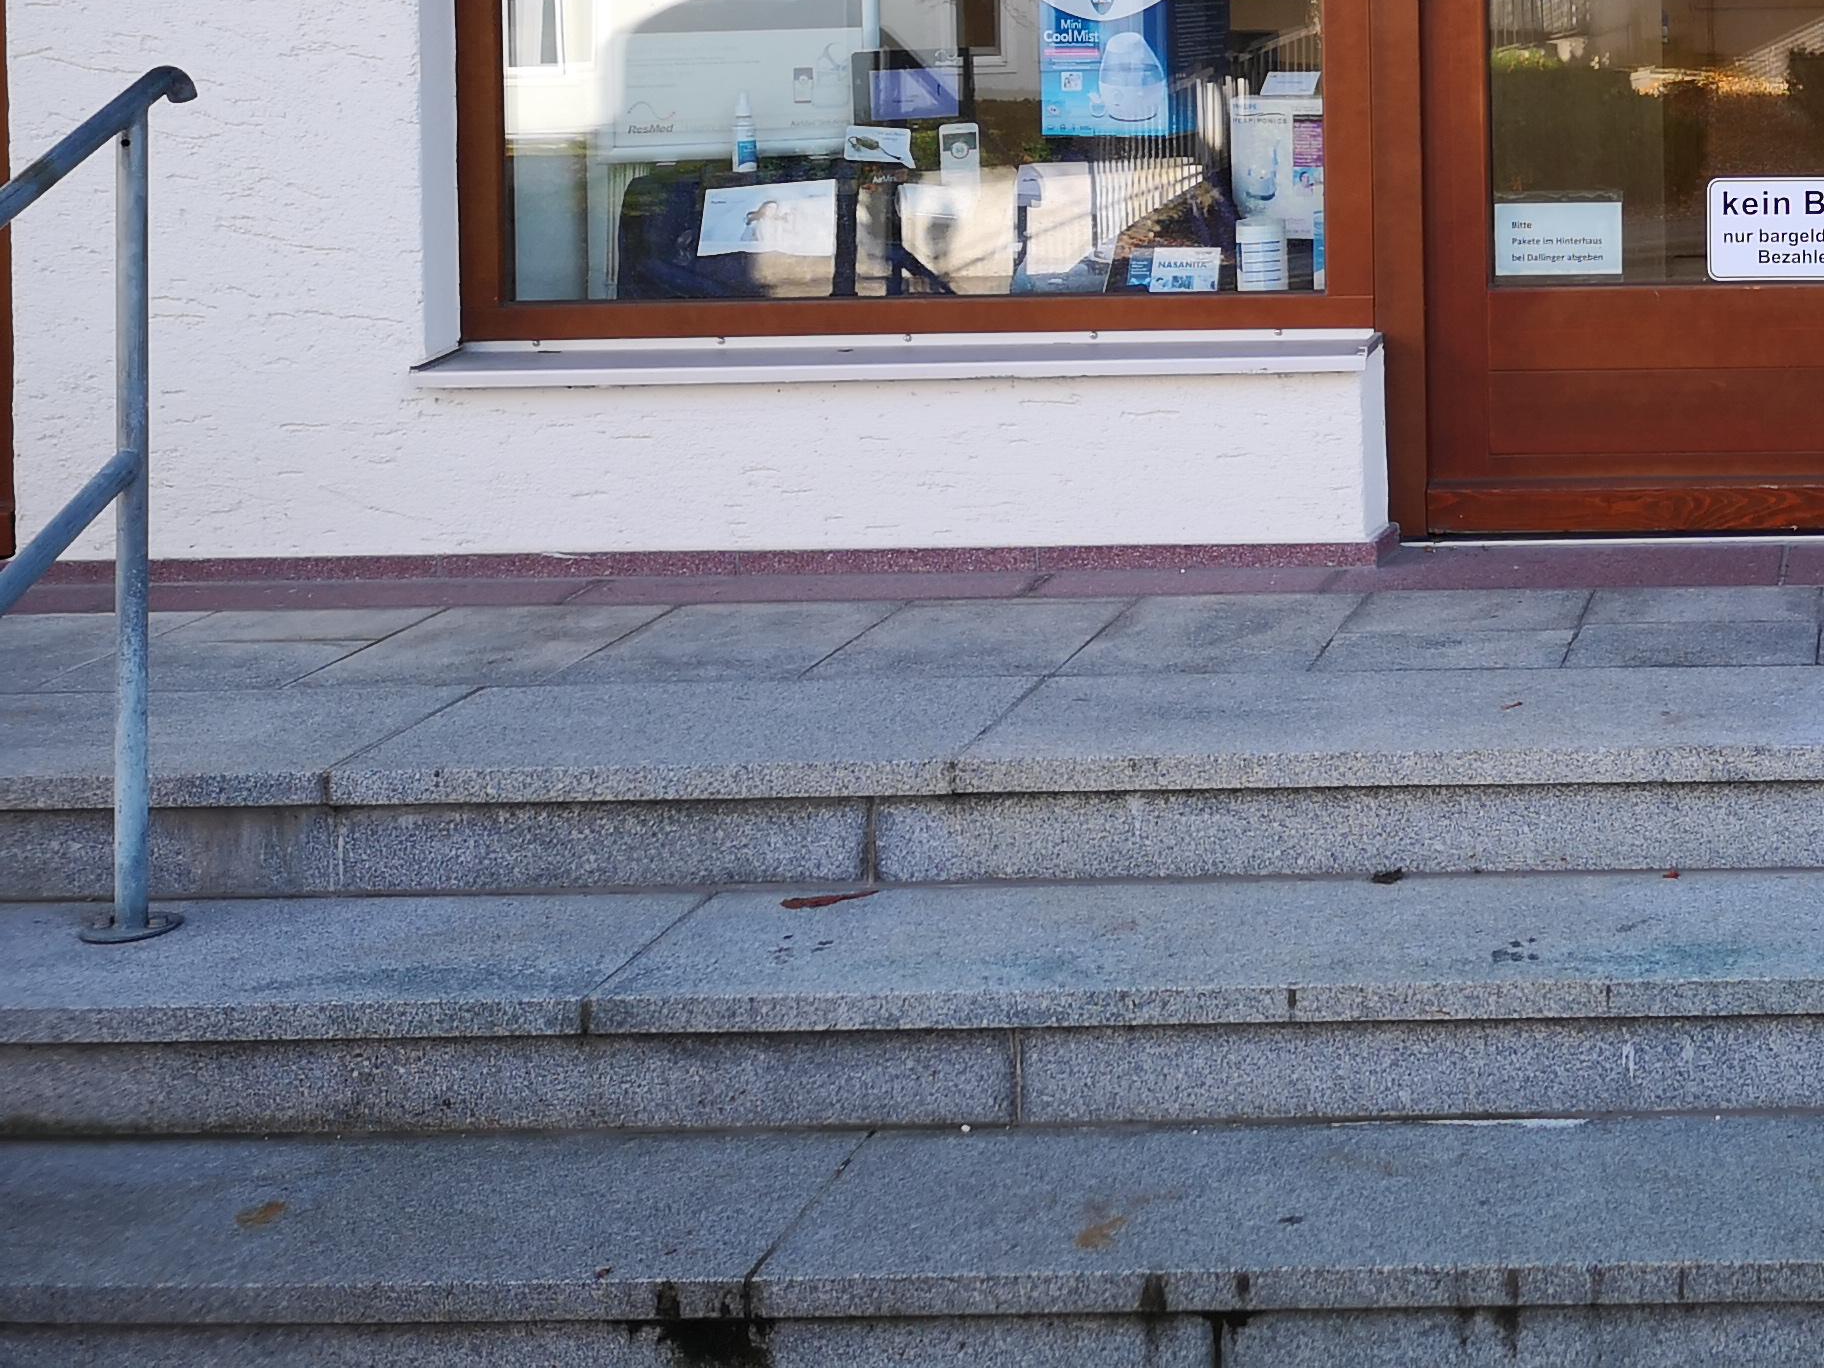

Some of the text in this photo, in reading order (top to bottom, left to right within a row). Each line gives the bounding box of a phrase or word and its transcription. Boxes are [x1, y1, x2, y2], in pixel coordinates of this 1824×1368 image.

[1060, 19, 1082, 30] Mini
[627, 123, 674, 135] ResMed
[1722, 190, 1791, 216] kein
[1511, 220, 1533, 230] Bitte
[1511, 236, 1603, 246] Pakete im Hinterhaus
[1723, 230, 1754, 244] nur
[1511, 253, 1526, 263] bei
[1567, 253, 1604, 263] abgeben
[1157, 260, 1208, 269] NASANITA
